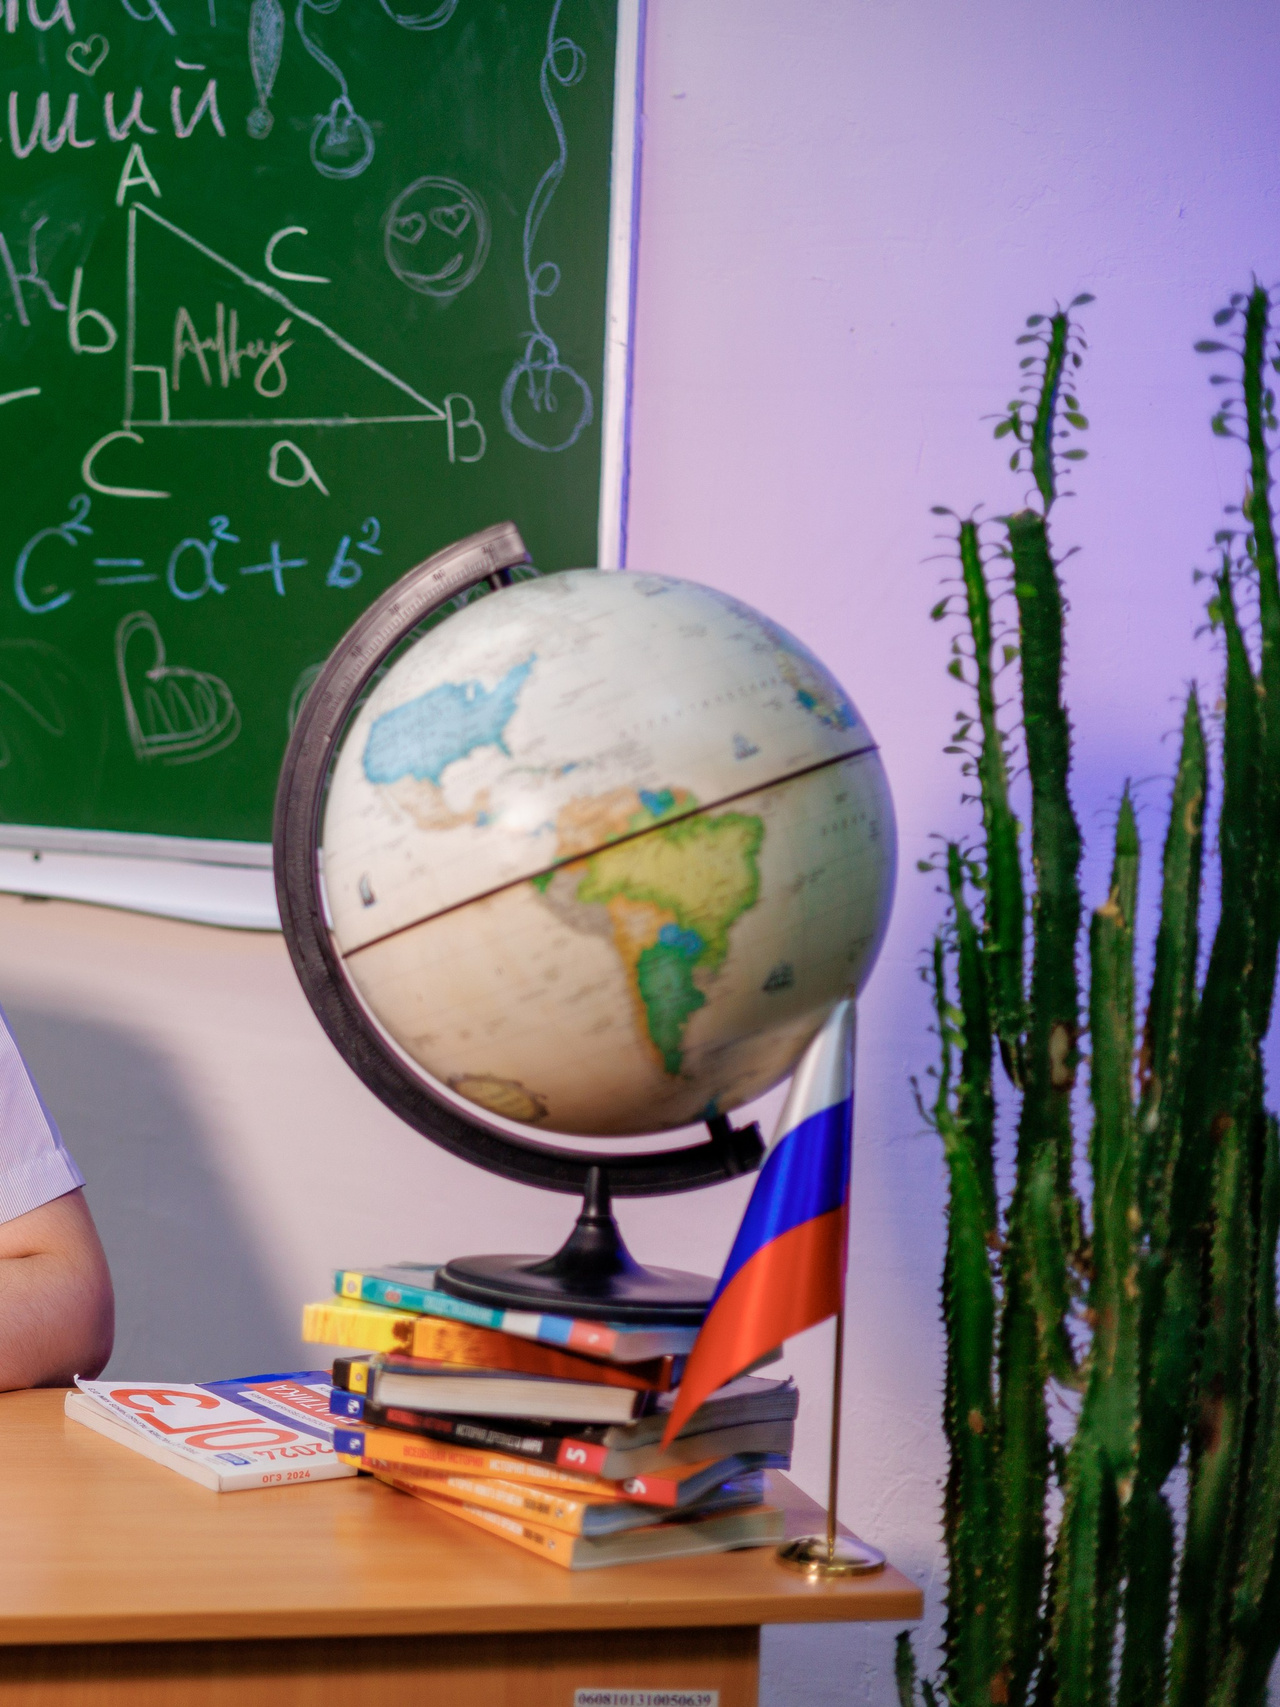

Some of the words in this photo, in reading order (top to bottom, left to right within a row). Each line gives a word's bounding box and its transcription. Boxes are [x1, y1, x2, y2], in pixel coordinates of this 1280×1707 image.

[116, 143, 162, 207] A
[444, 393, 487, 464] B
[565, 1447, 587, 1464] 5
[262, 1474, 283, 1484] ОГЭ
[287, 1470, 311, 1481] 2024
